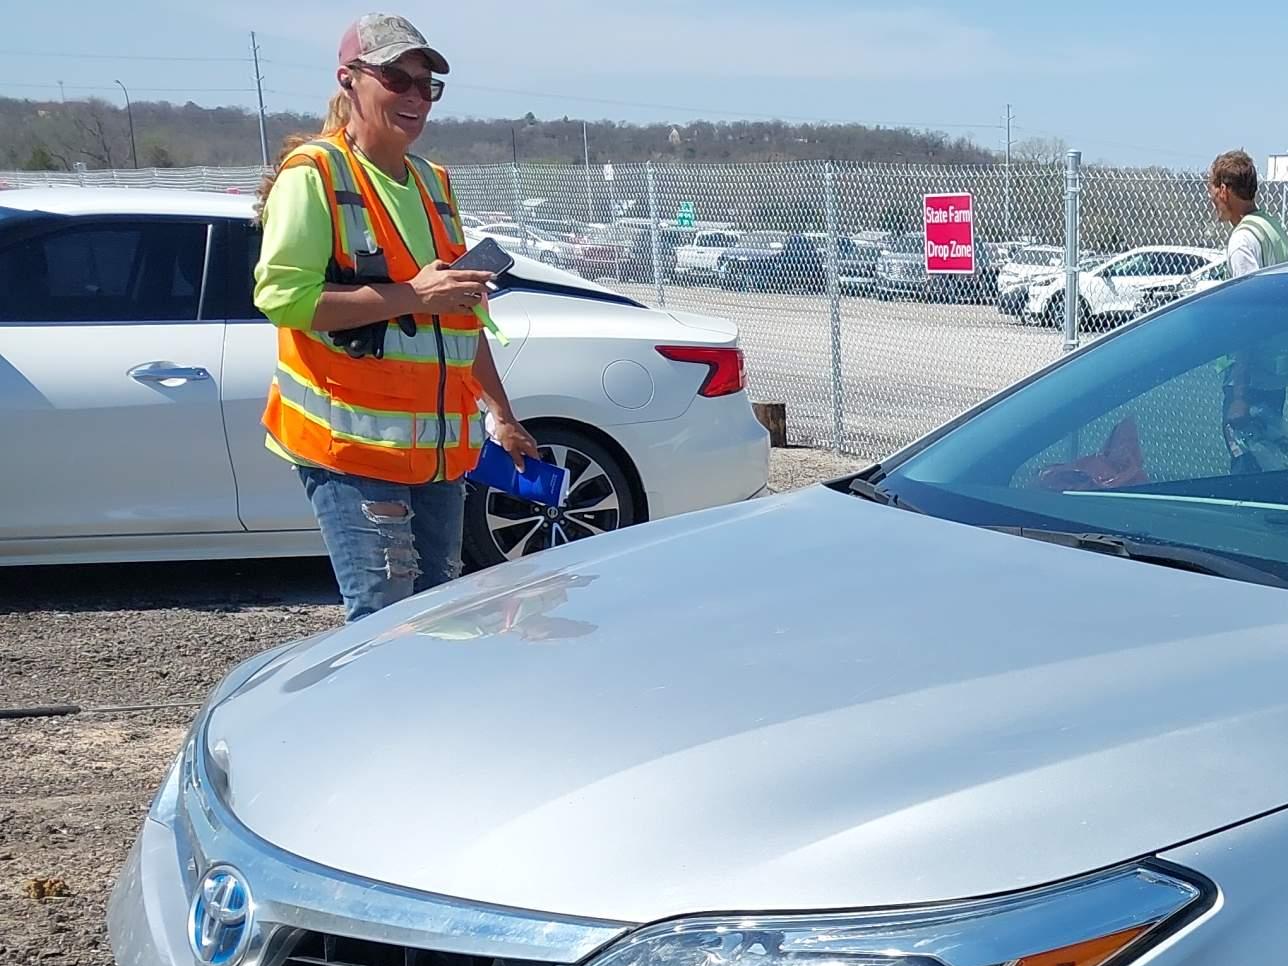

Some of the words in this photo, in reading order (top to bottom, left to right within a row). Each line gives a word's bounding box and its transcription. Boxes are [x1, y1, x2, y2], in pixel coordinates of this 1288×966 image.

[926, 206, 948, 224] State
[949, 205, 971, 223] Farm
[928, 240, 949, 261] Drop
[950, 240, 971, 258] Zone
